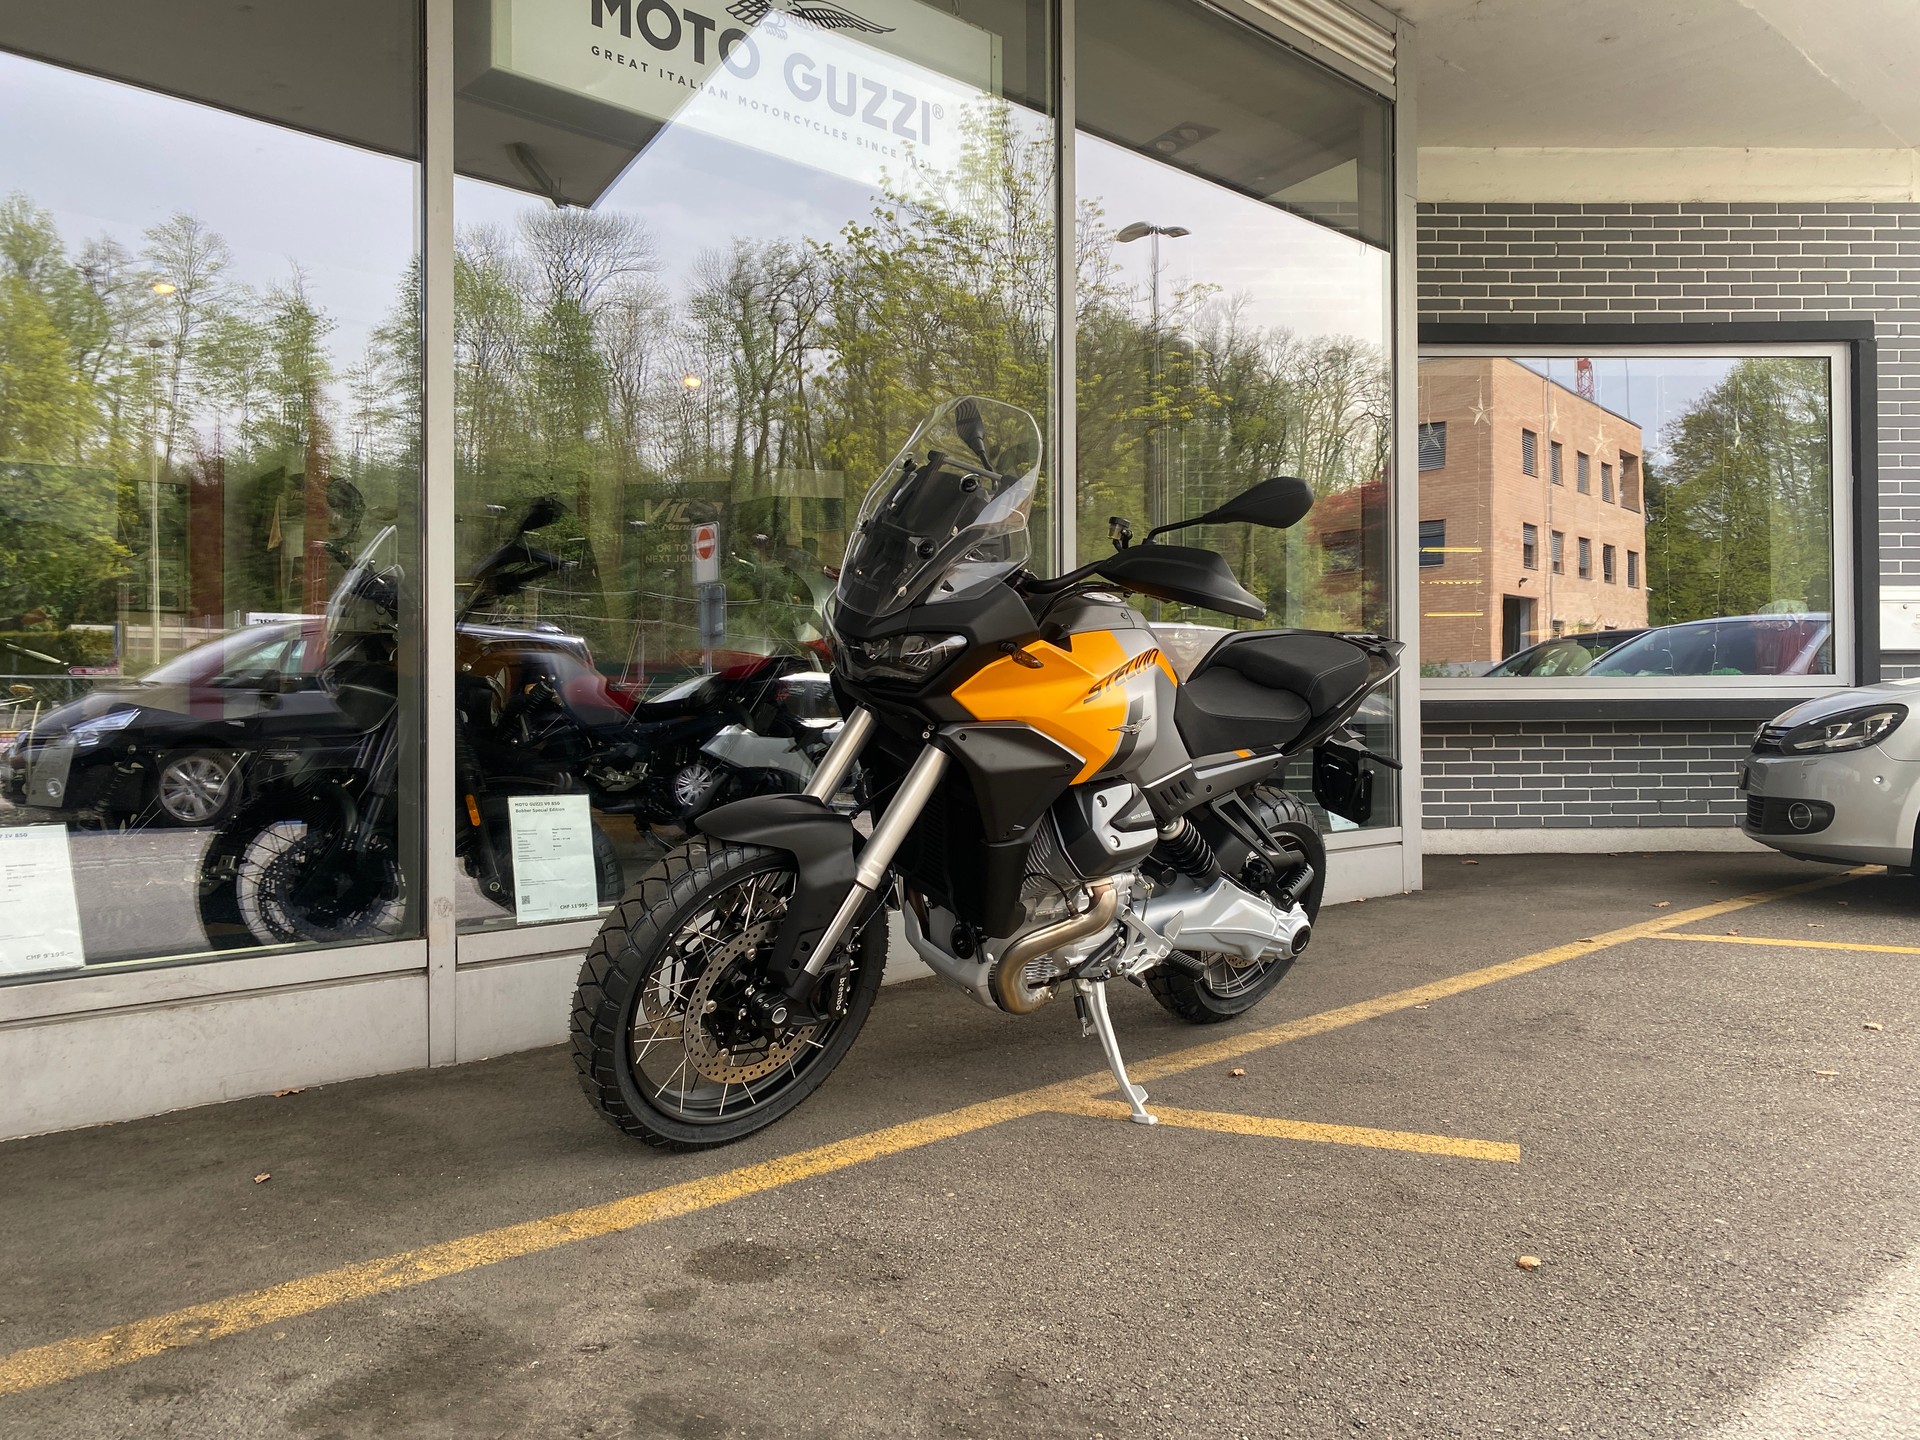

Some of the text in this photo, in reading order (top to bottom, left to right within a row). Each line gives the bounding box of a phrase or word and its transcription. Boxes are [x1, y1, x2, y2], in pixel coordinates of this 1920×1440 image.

[591, 0, 760, 80] MOTO
[591, 45, 649, 73] GREAT
[659, 68, 729, 101] ITALIAN
[738, 95, 849, 142] MOTORCYCLES
[856, 136, 898, 159] SINCE
[646, 555, 672, 563] NEXT
[656, 544, 671, 552] ON
[674, 544, 688, 552] TO
[1083, 648, 1159, 704] STELVIO
[25, 953, 41, 961] CHF
[836, 976, 847, 1011] brembo
